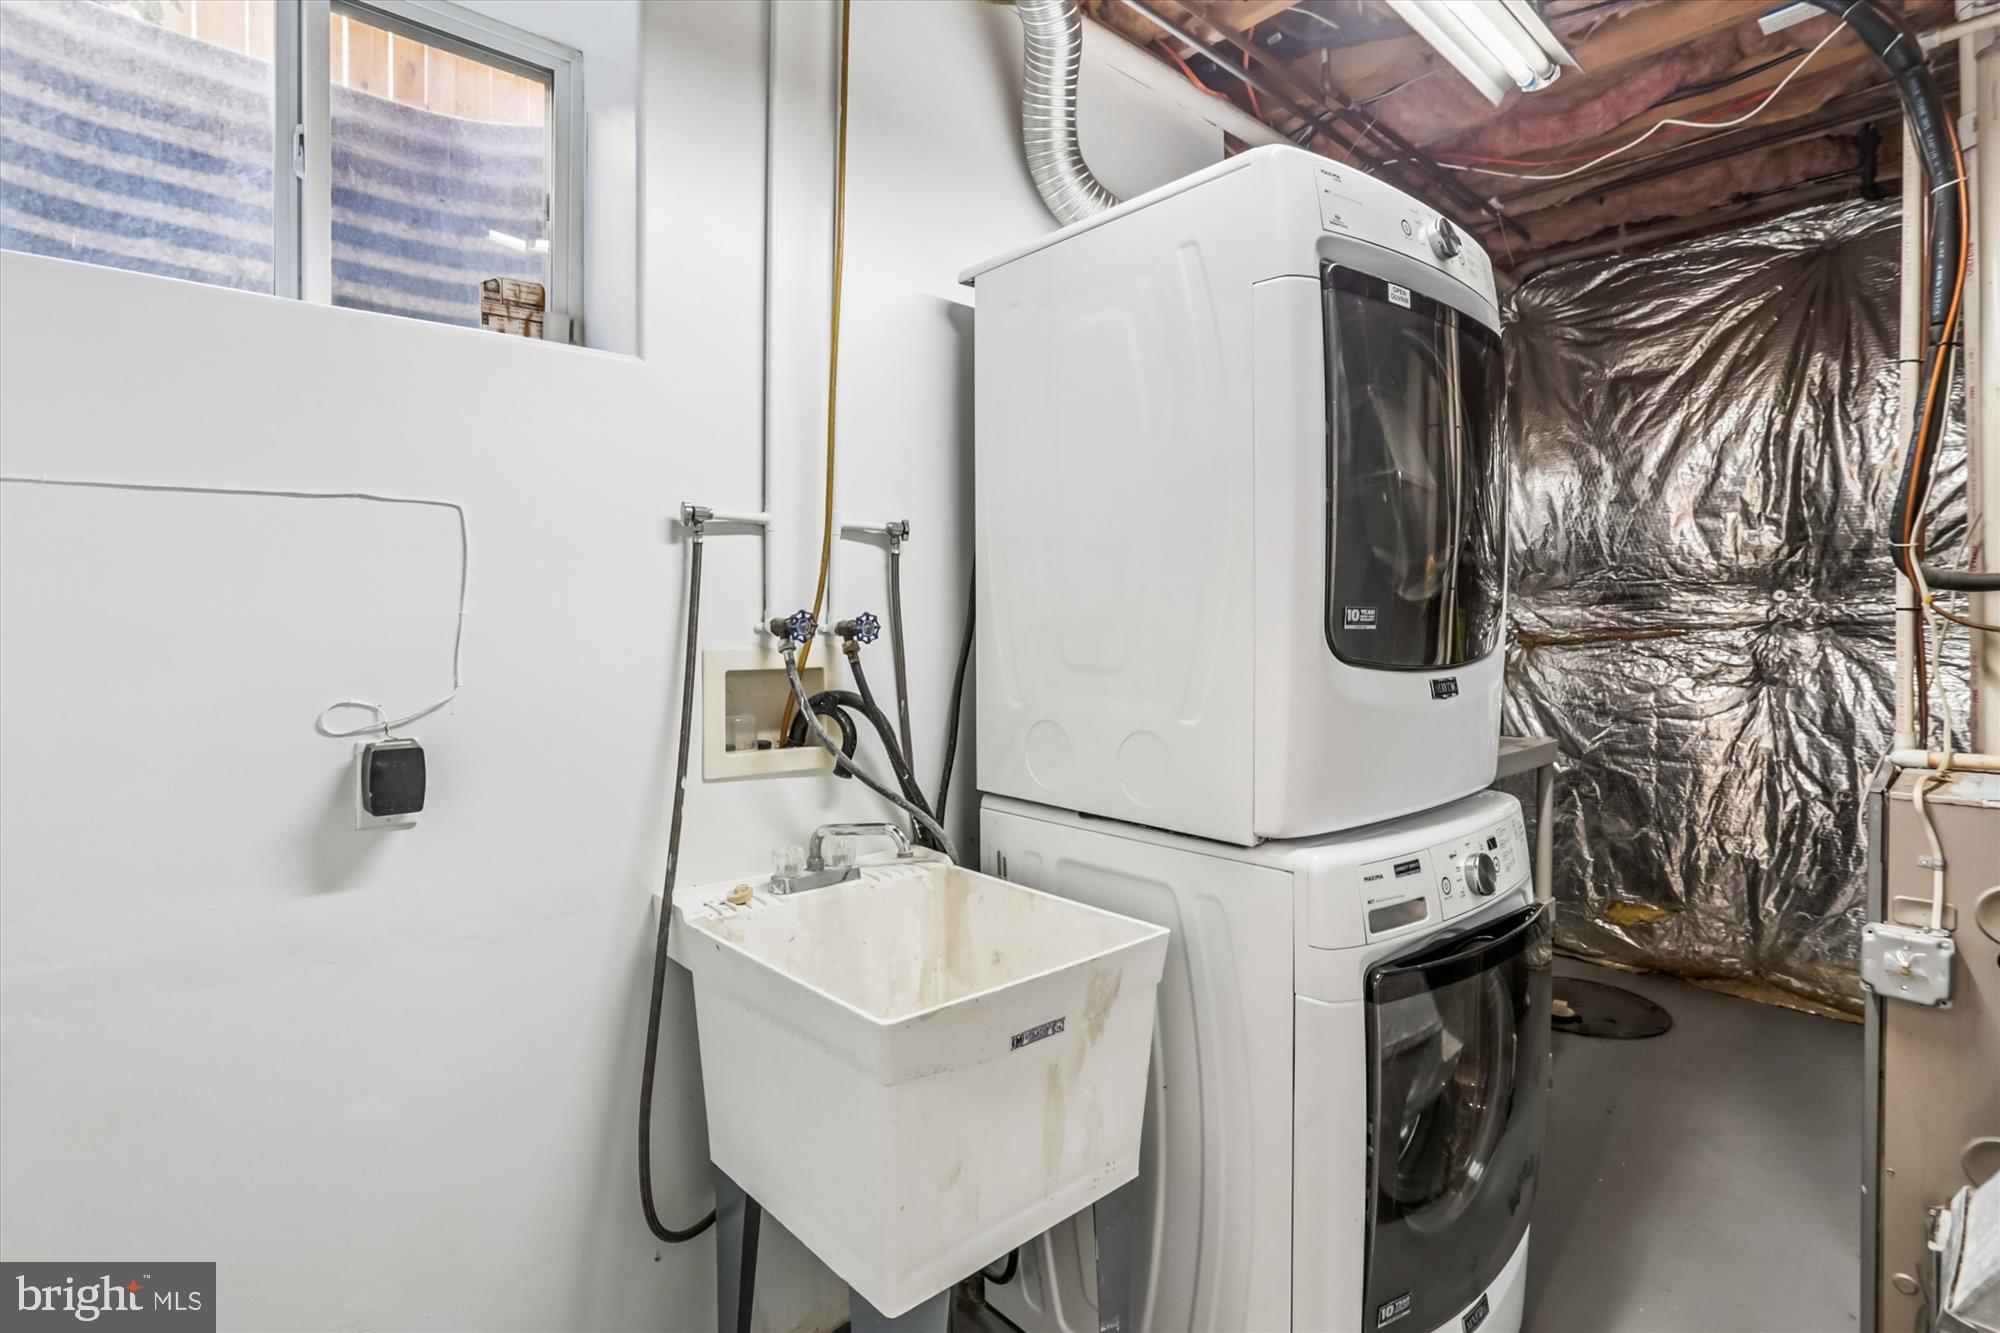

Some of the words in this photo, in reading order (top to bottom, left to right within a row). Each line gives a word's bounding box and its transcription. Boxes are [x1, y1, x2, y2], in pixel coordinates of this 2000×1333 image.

[1393, 286, 1407, 296] OPEN
[1347, 609, 1360, 621] 10
[1363, 873, 1384, 882] MAXIMA
[1381, 1304, 1394, 1320] 10
[1395, 1296, 1410, 1306] YEAR
